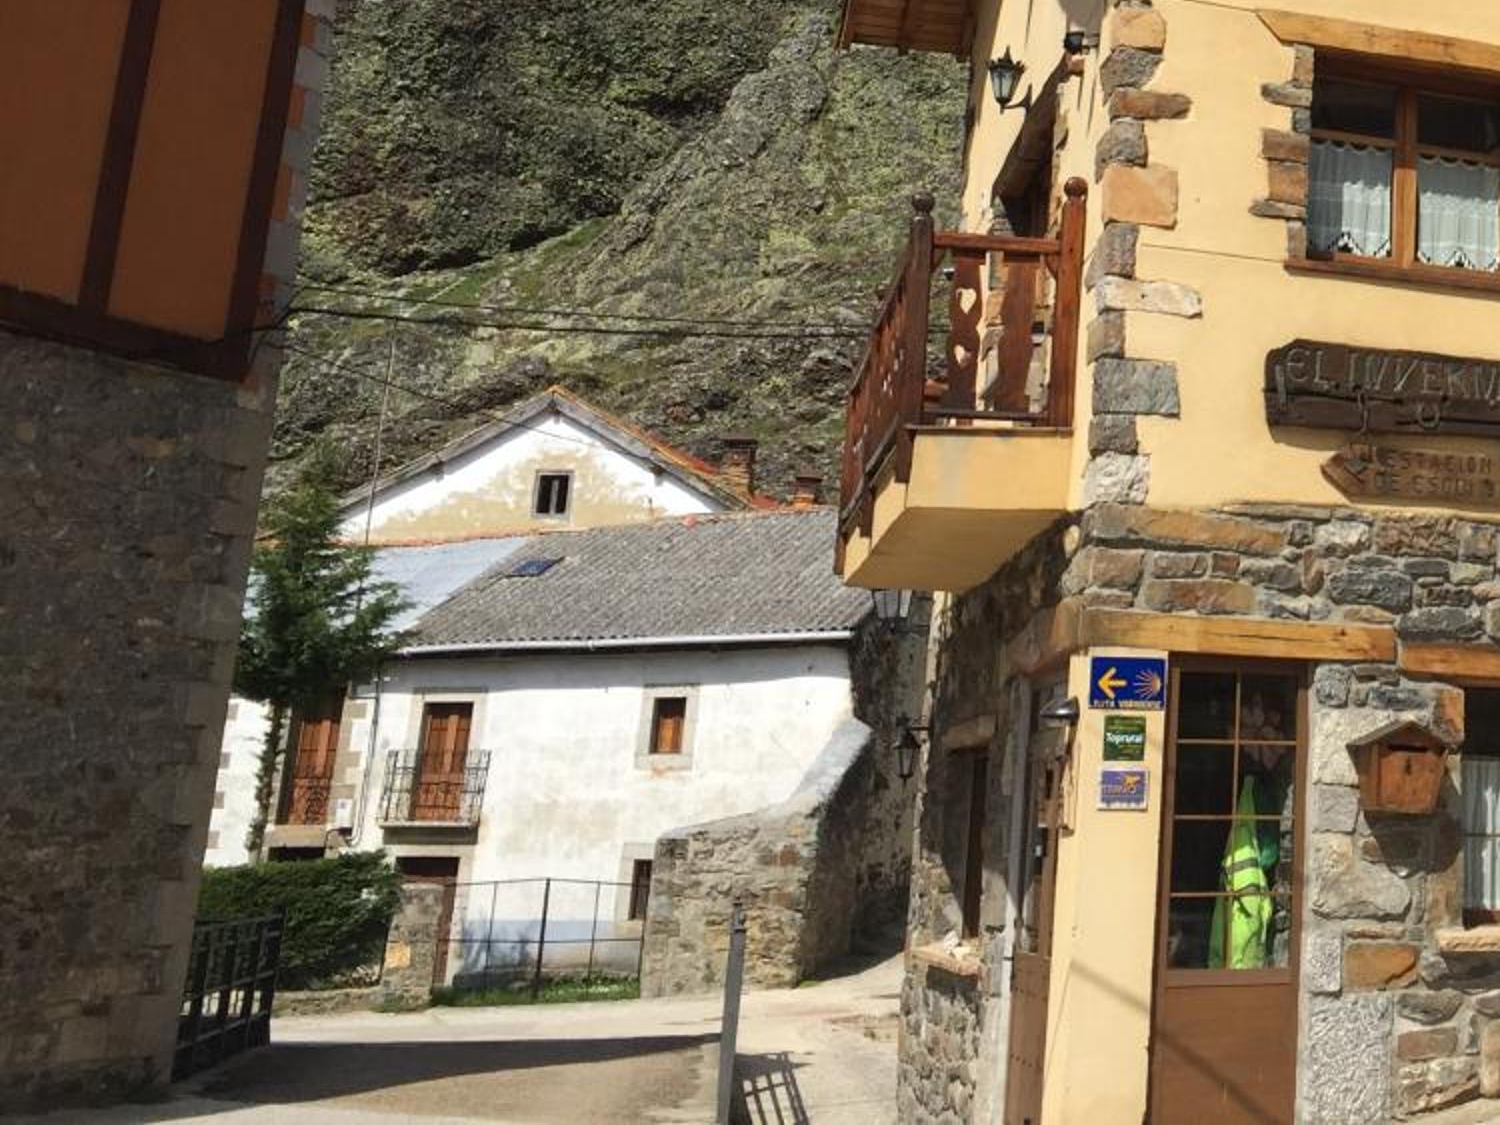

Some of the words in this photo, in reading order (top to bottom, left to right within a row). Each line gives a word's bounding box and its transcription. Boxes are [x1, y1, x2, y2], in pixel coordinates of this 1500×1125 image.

[1286, 347, 1331, 389] EL
[1374, 471, 1401, 492] DE
[1106, 732, 1143, 745] Toprural
